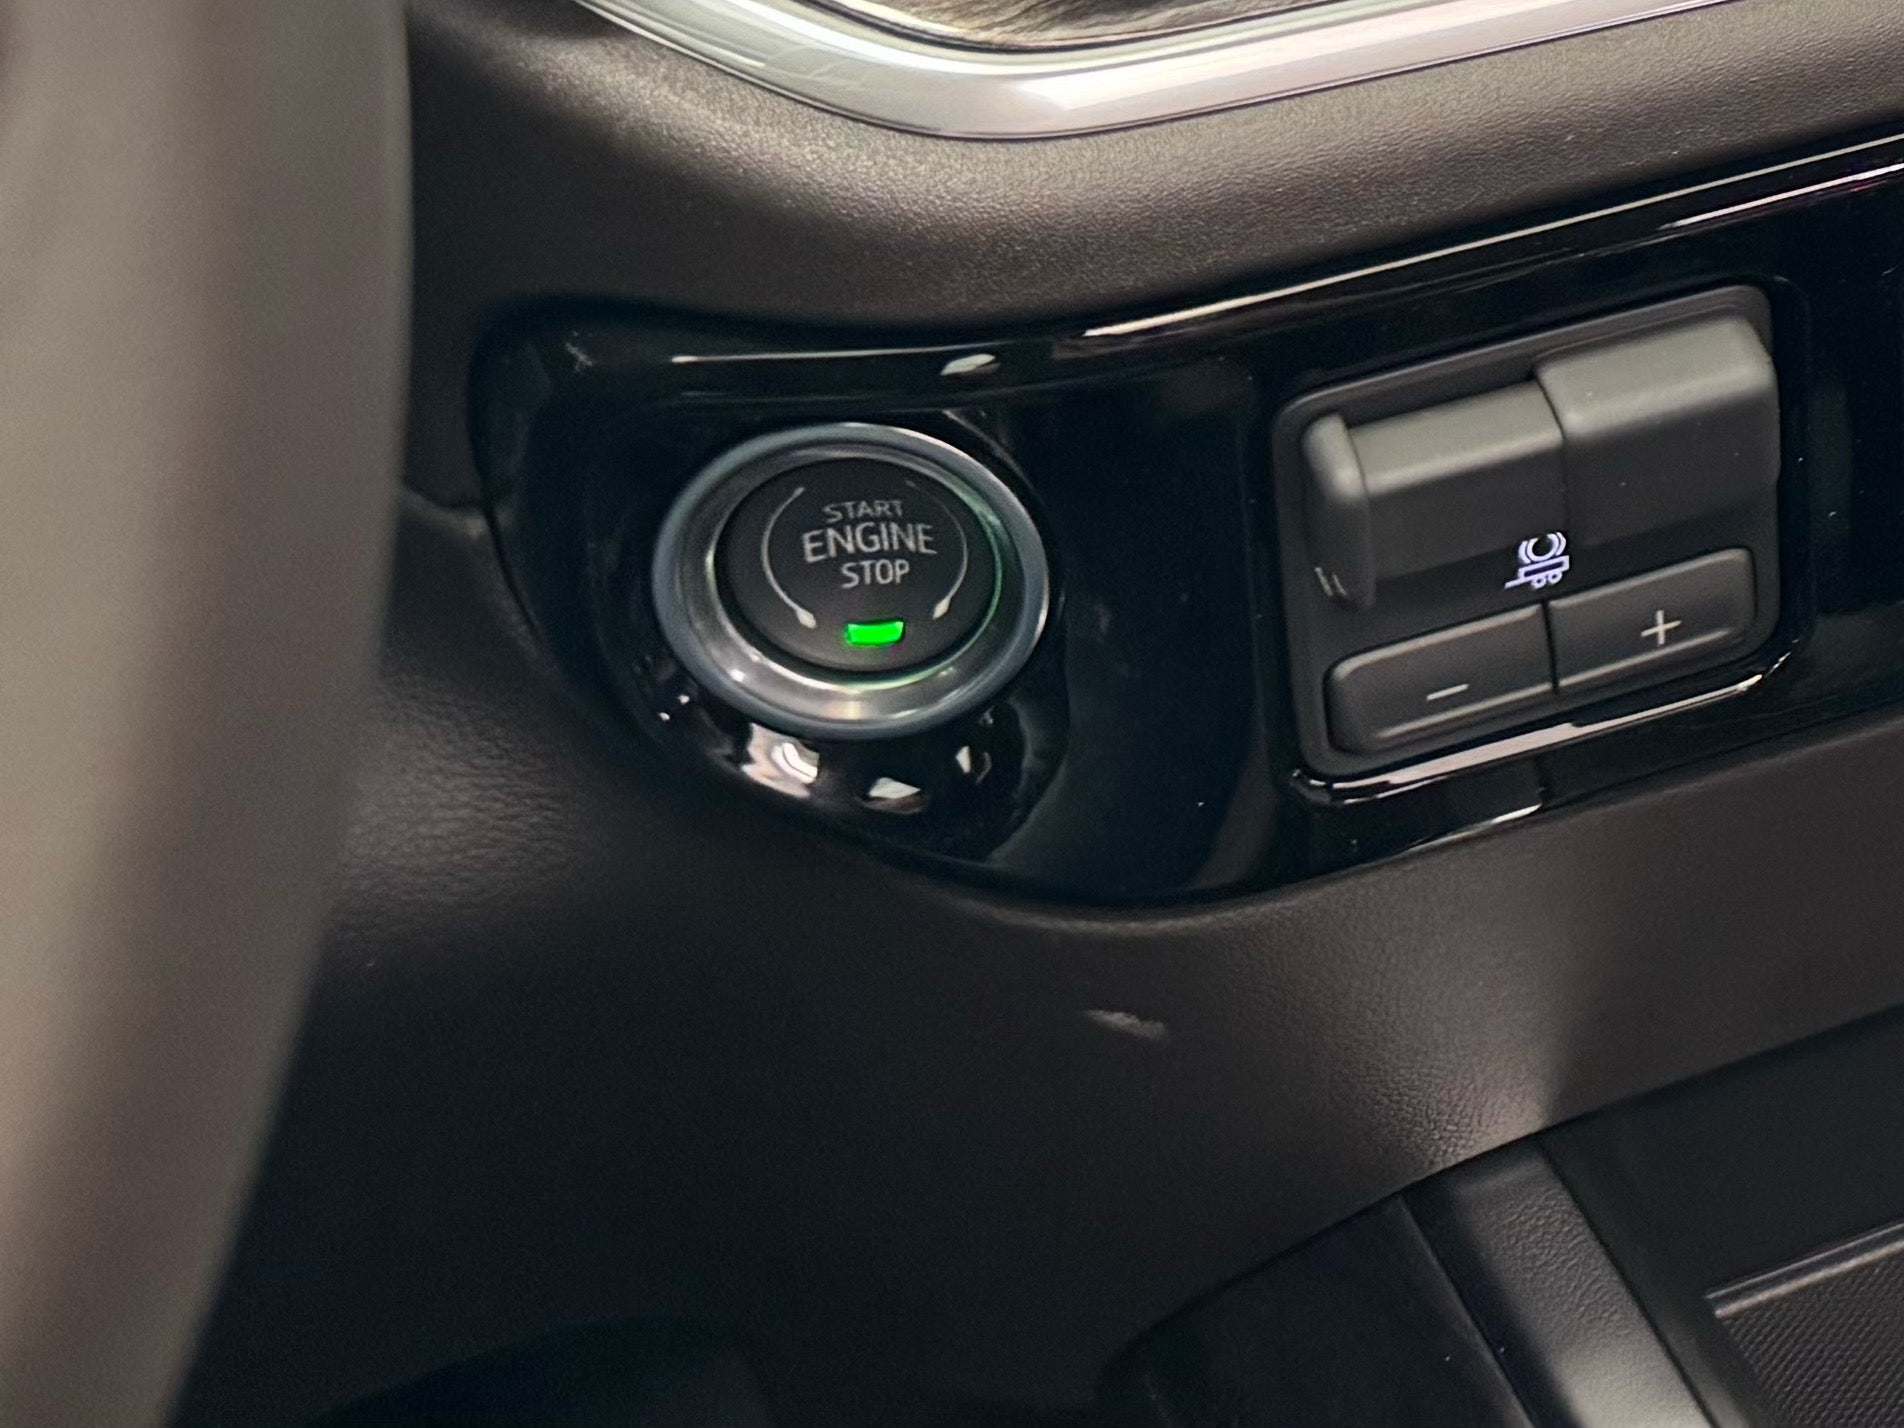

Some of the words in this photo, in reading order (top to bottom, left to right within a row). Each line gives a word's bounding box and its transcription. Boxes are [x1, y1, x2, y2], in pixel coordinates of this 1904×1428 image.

[822, 500, 904, 522] START
[801, 521, 938, 562] ENGINE
[840, 560, 910, 590] STOP
